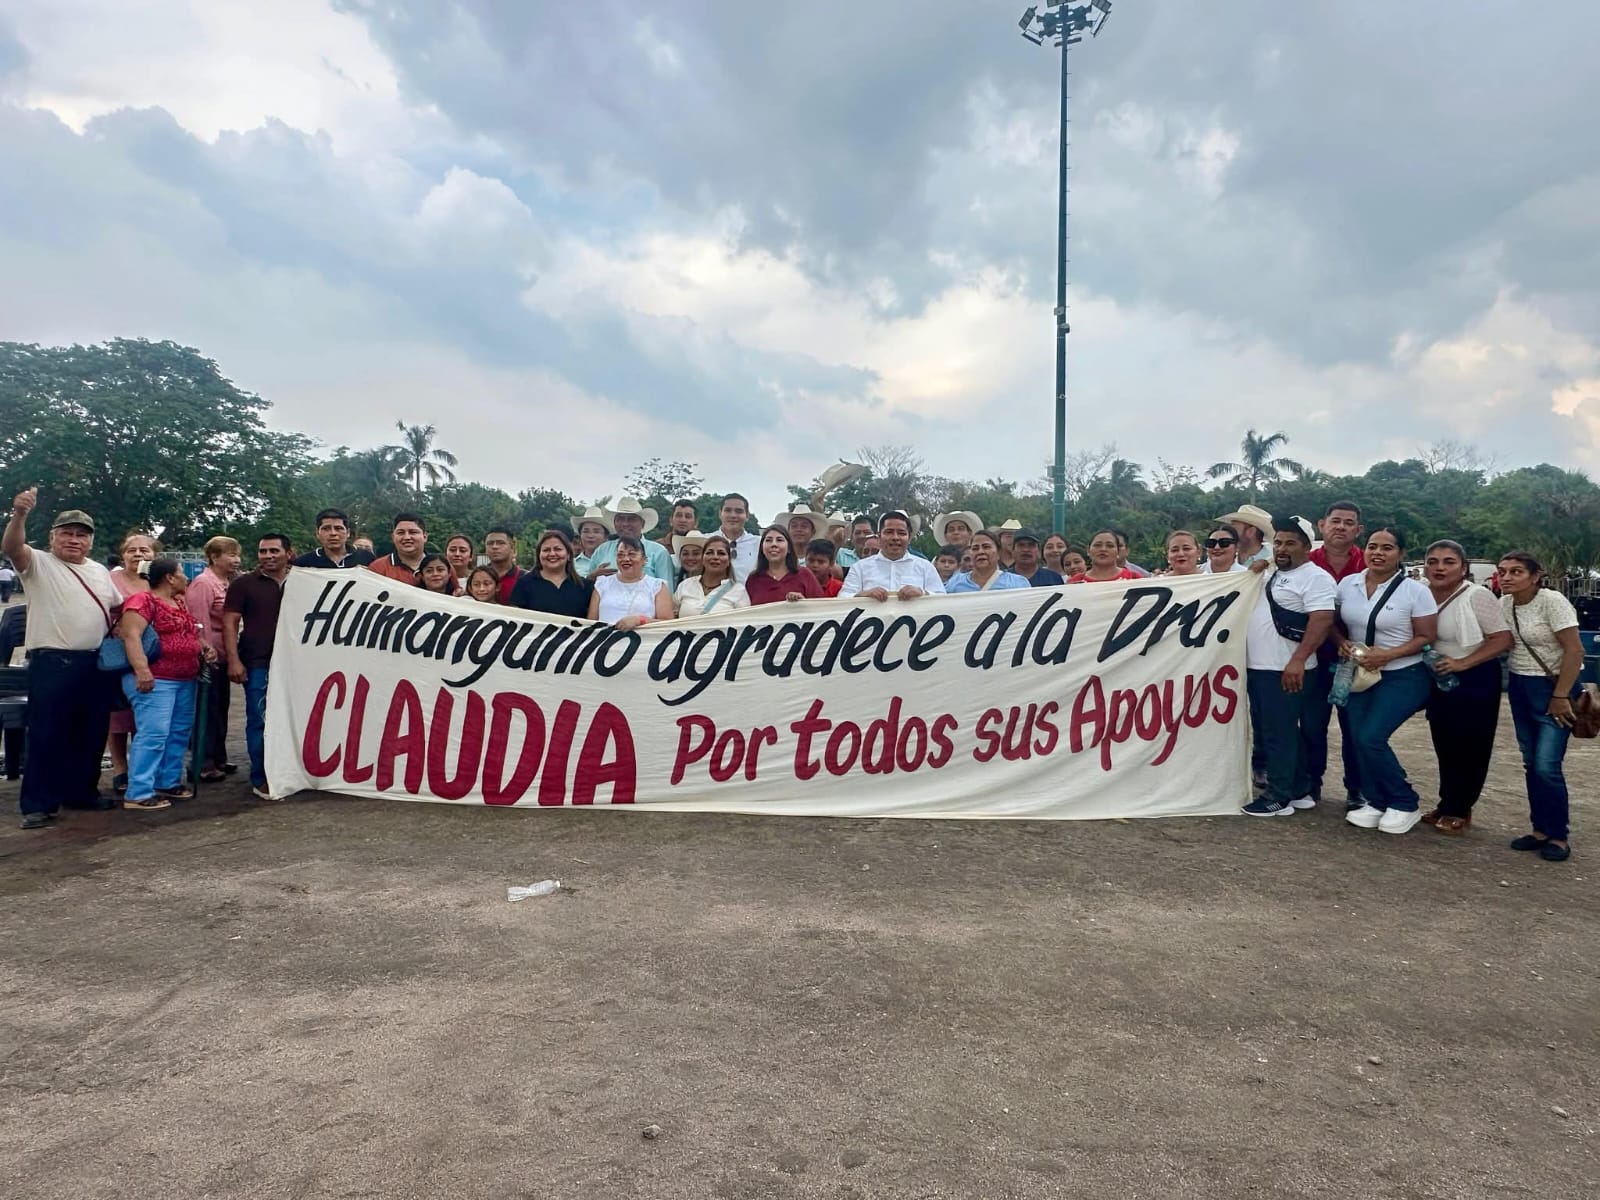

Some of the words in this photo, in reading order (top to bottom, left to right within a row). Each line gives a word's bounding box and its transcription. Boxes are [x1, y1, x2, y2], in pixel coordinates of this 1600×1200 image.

[301, 580, 641, 687] Huimanguillo
[647, 607, 955, 706] agradece
[964, 611, 1017, 670] a
[1011, 592, 1083, 668] la
[1097, 586, 1241, 663] Dra.
[303, 671, 637, 807] CLAUDIA
[670, 714, 778, 786] Por
[790, 696, 958, 781] todos
[973, 700, 1059, 763] sus
[1069, 664, 1239, 772] Apoyos
